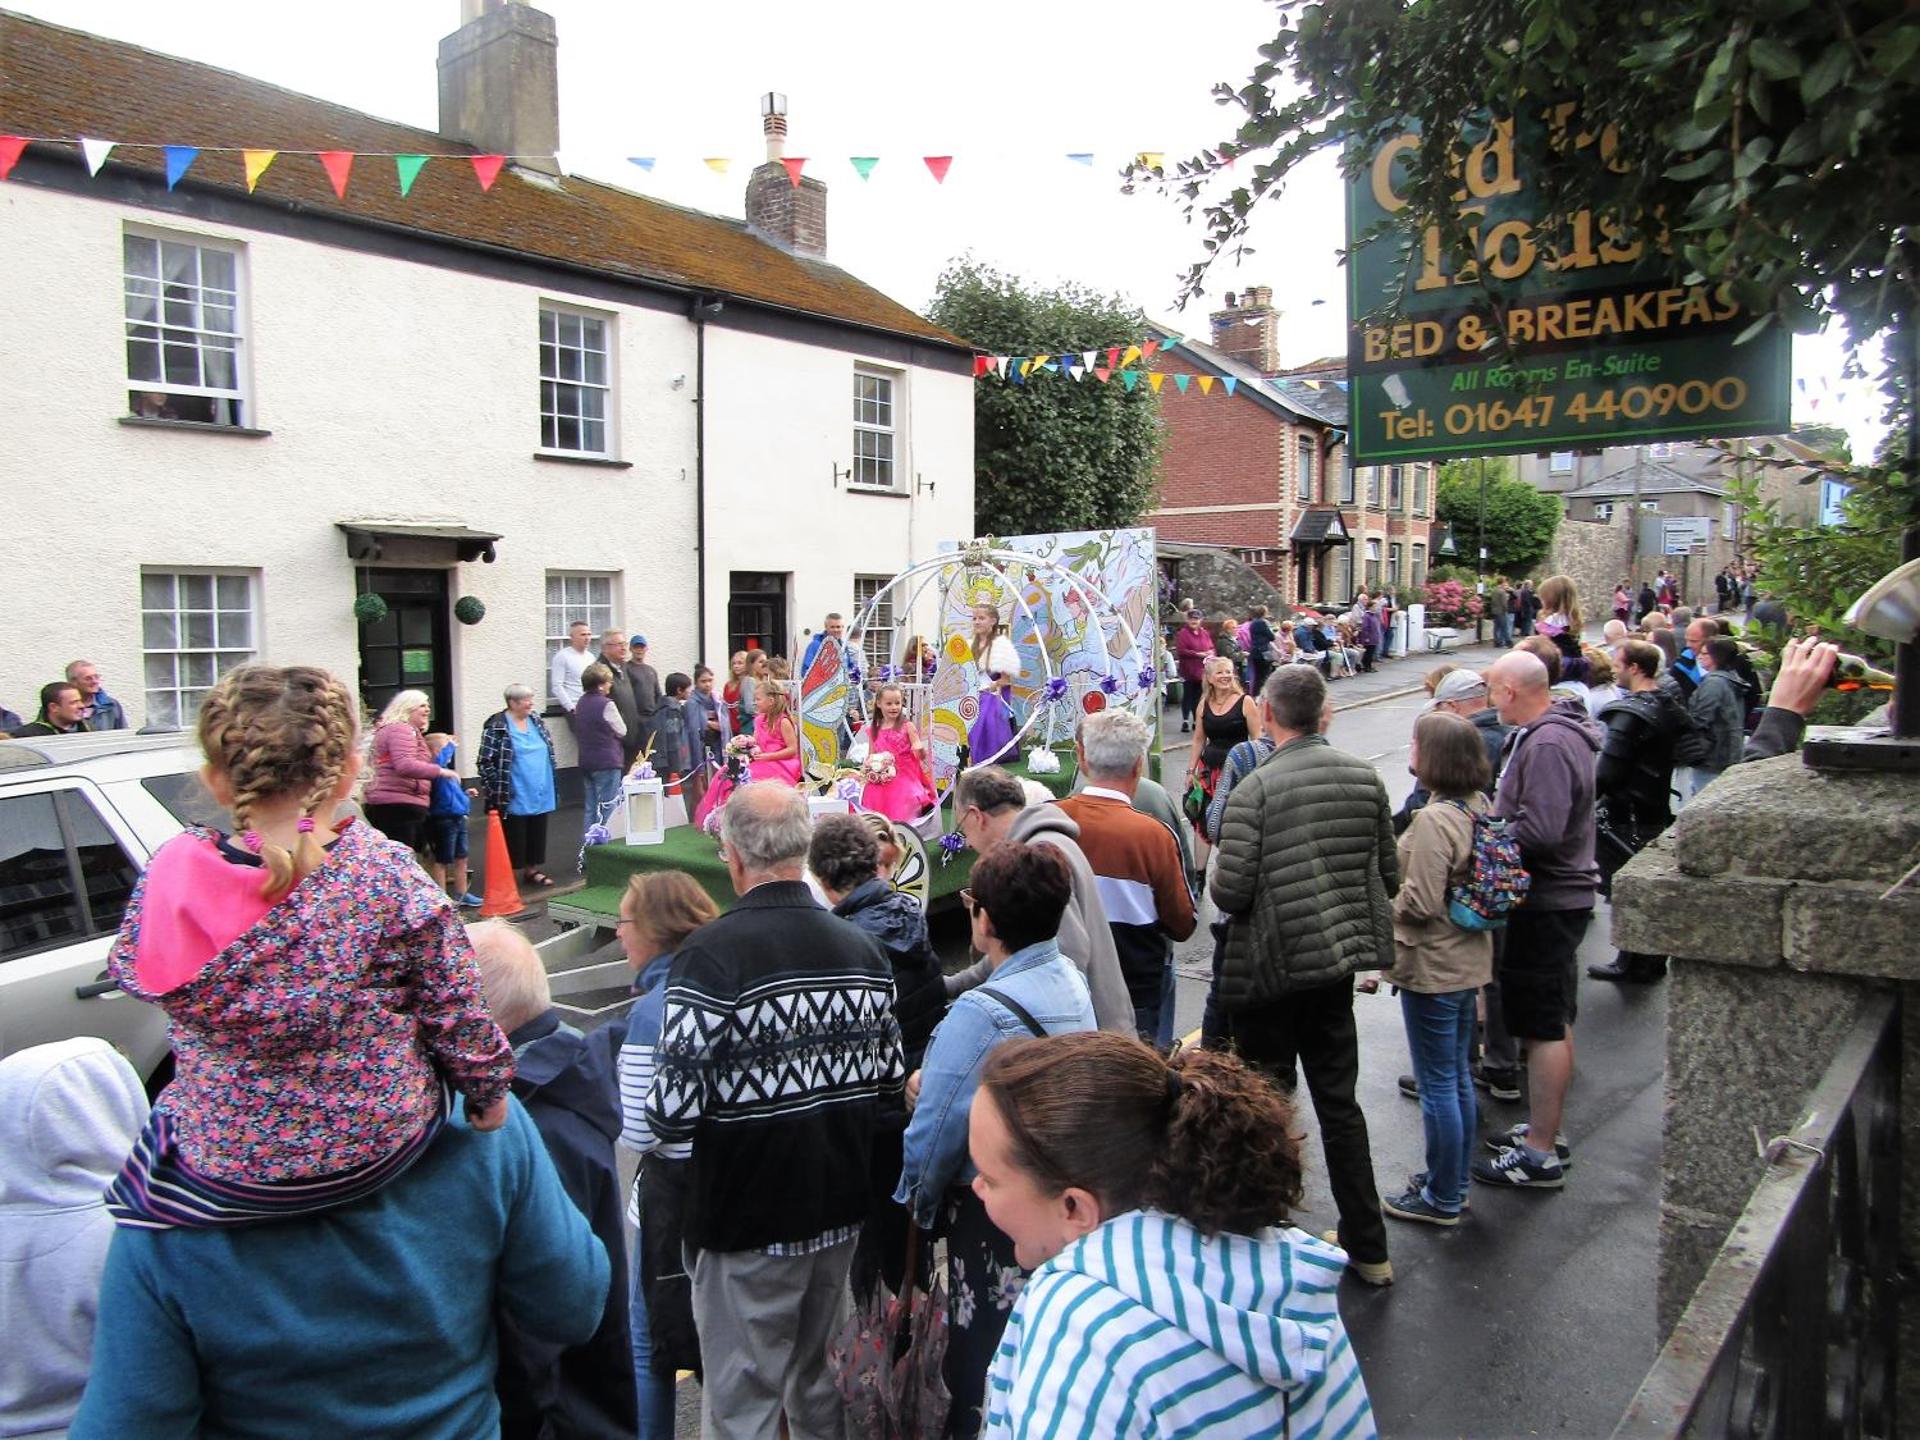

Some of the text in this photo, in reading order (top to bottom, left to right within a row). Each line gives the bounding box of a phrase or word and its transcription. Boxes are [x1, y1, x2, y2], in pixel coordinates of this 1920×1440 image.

[1364, 279, 1742, 362] BED & BREAKFAS
[1451, 368, 1480, 391] All
[1565, 353, 1661, 380] En-Suite
[1379, 376, 1747, 440] Tel: 01647 440900
